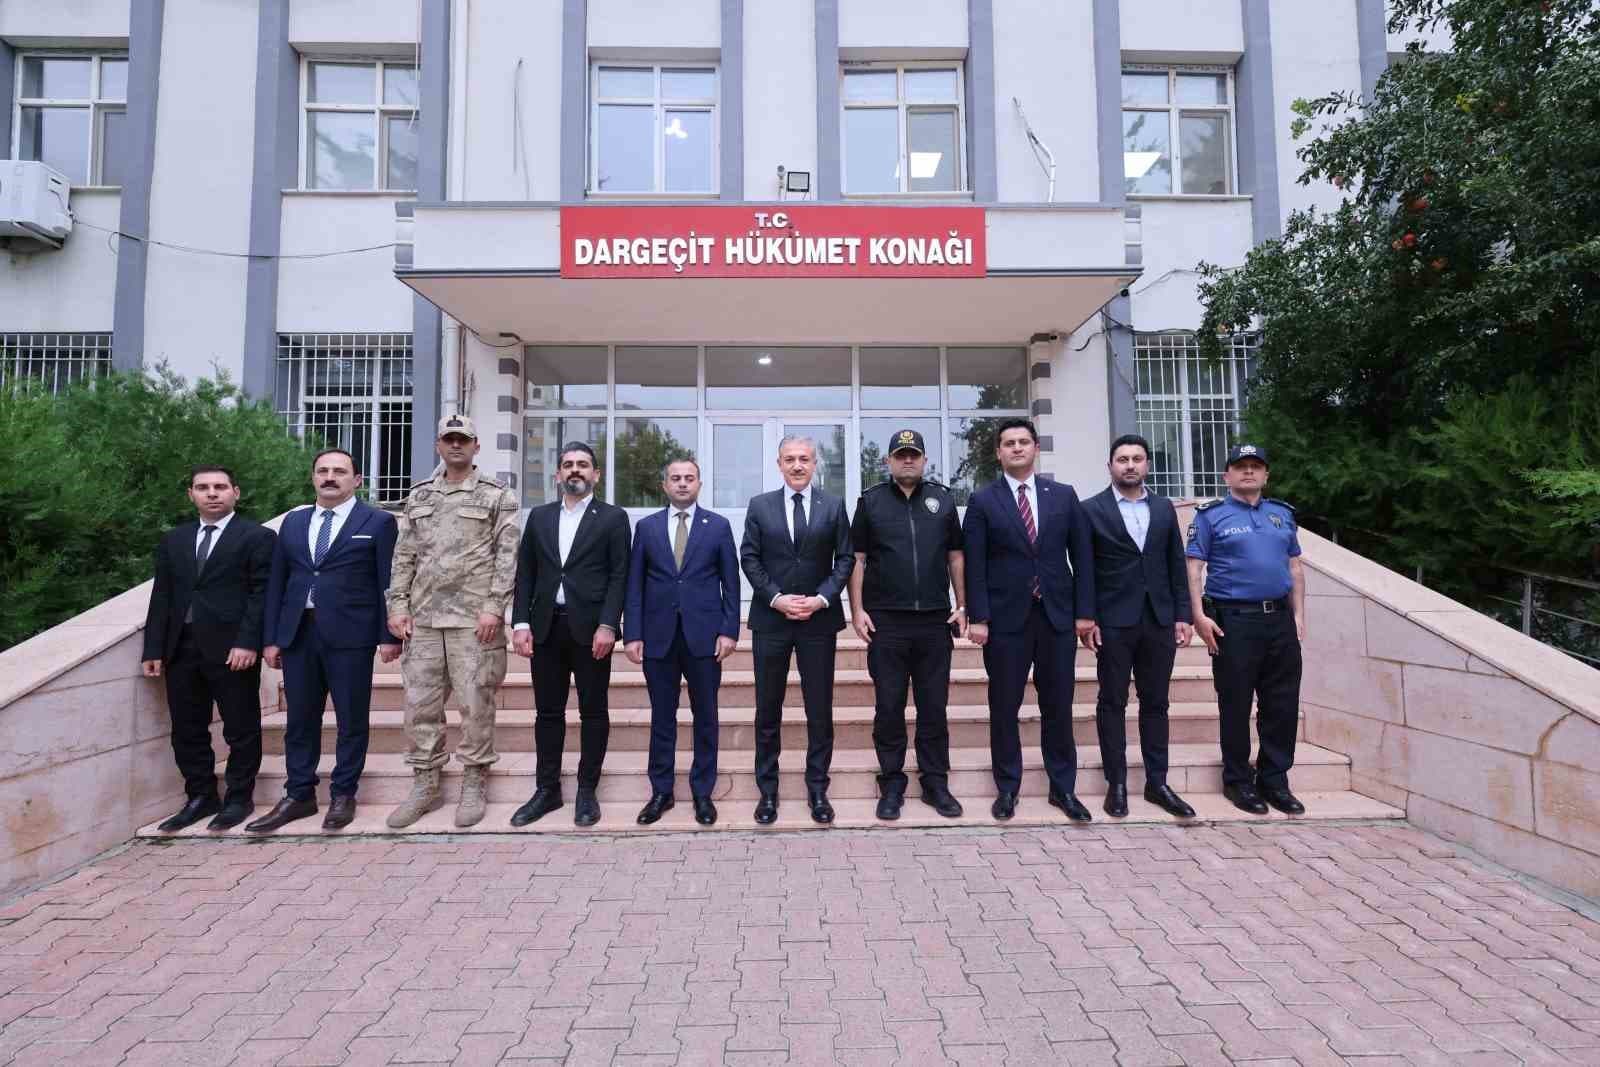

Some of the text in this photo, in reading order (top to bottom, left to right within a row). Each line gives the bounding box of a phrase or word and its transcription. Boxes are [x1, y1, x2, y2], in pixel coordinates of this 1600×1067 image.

[575, 230, 973, 272] DARGEÇİT HÜKÜMET KONAĞI
